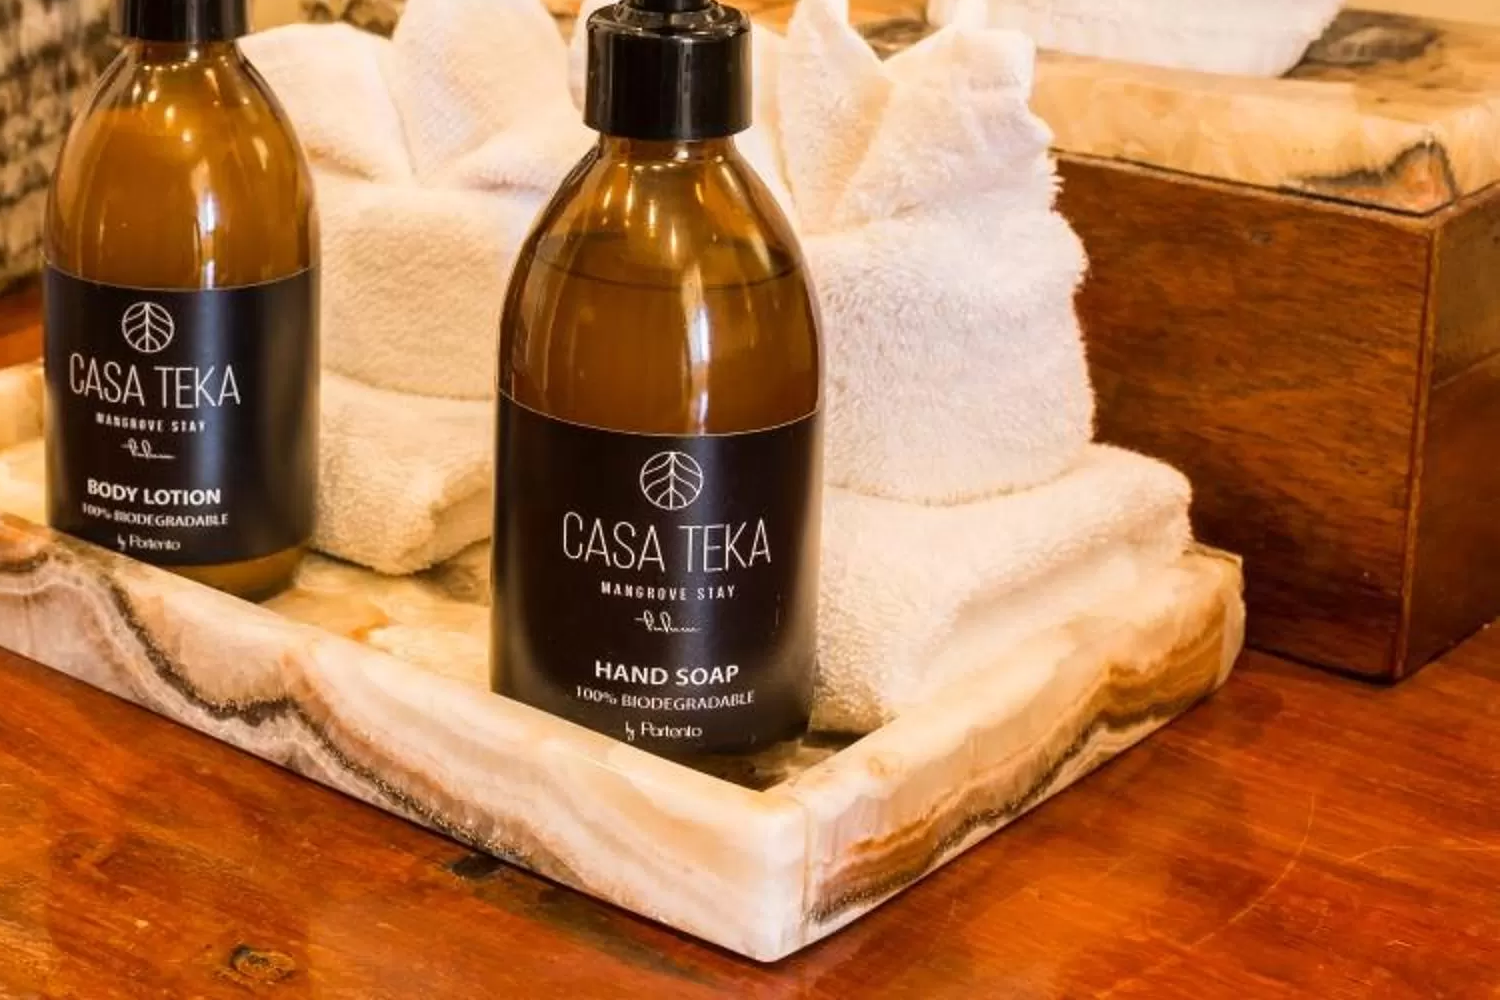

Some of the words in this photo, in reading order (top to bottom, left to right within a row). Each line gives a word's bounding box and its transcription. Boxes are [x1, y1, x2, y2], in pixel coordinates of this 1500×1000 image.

[69, 352, 145, 407] CASA
[153, 364, 241, 409] TEKA
[96, 412, 164, 432] MANGROVE
[171, 420, 206, 432] STAY
[87, 478, 138, 501] BODY
[143, 488, 222, 505] LOTION
[82, 502, 112, 519] 100%
[114, 511, 229, 526] BIODEGRADABLE
[562, 511, 666, 573] CASA
[677, 517, 772, 573] TEKA
[600, 580, 687, 601] MANGROVE
[697, 585, 736, 601] STAY
[595, 660, 669, 686] HAND
[675, 664, 740, 687] SOAP
[576, 685, 617, 705] 100%
[621, 690, 755, 711] BIODEGRADABLE
